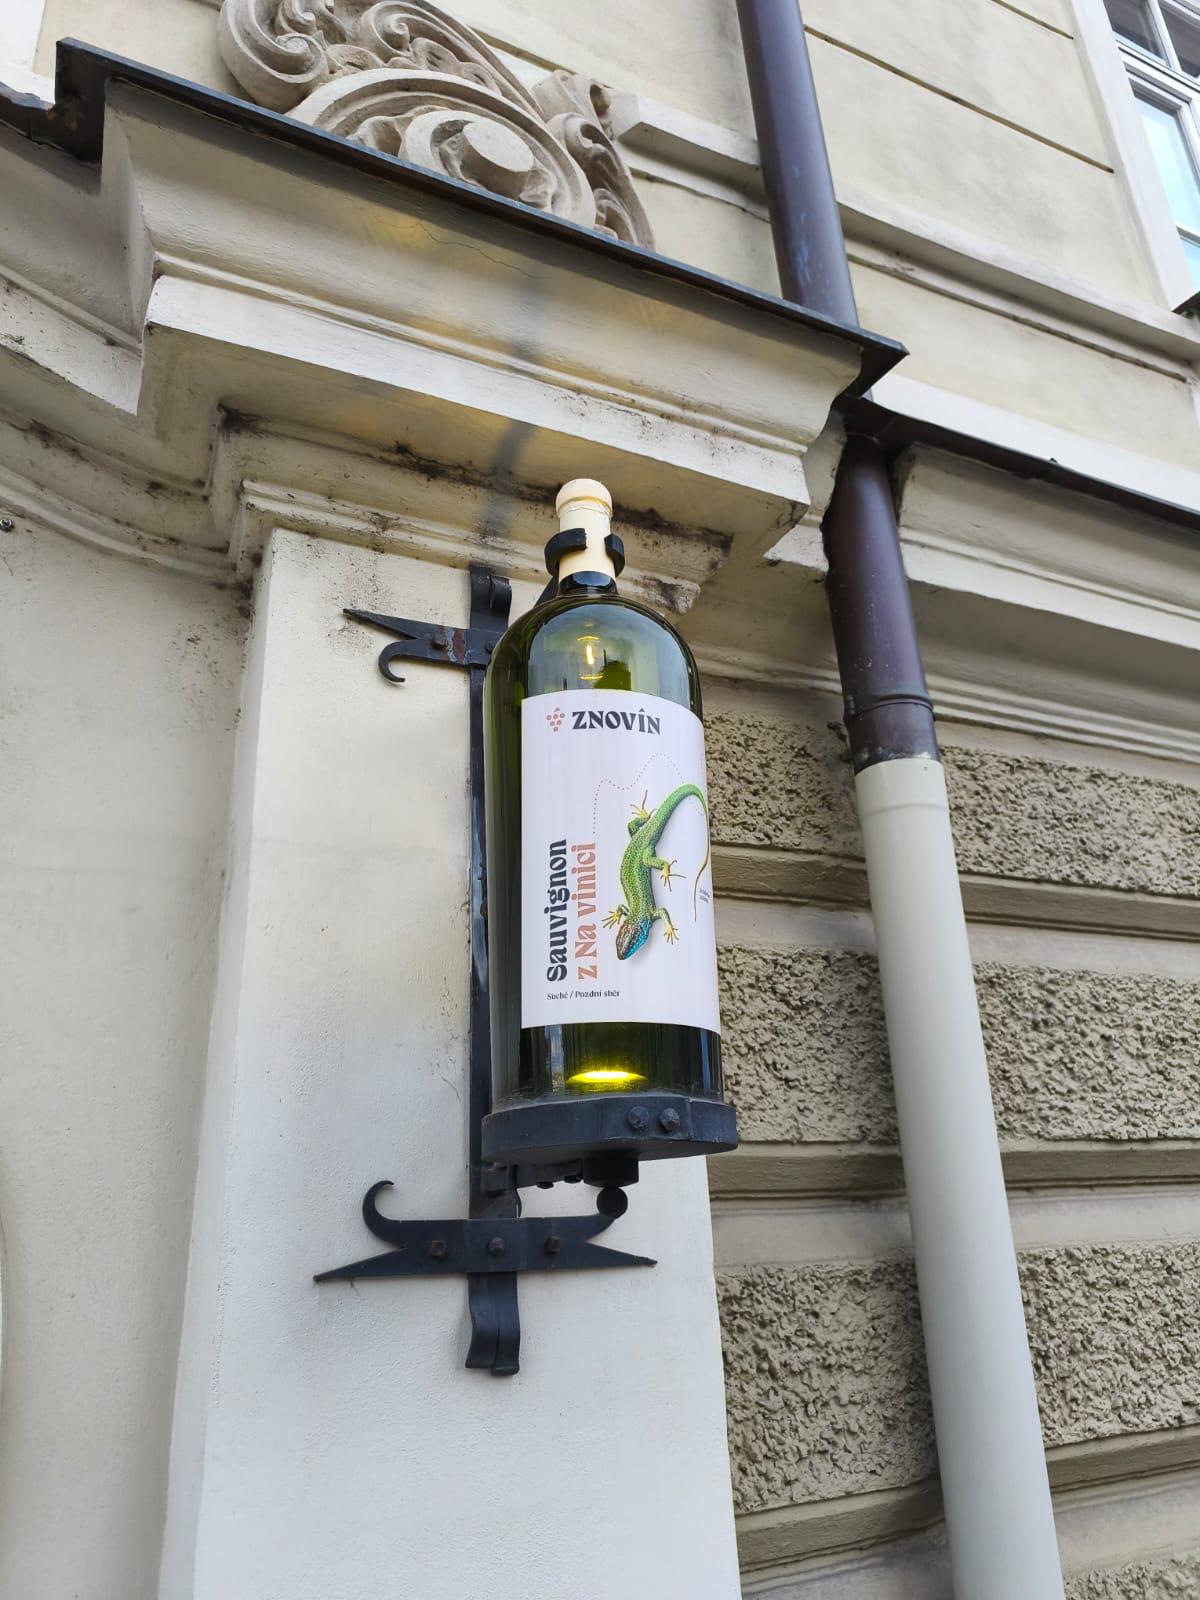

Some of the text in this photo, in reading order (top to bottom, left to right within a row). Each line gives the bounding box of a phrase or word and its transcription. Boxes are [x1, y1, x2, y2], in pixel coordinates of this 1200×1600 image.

[544, 839, 570, 982] Sauvignon
[571, 843, 597, 980] z Na vinici
